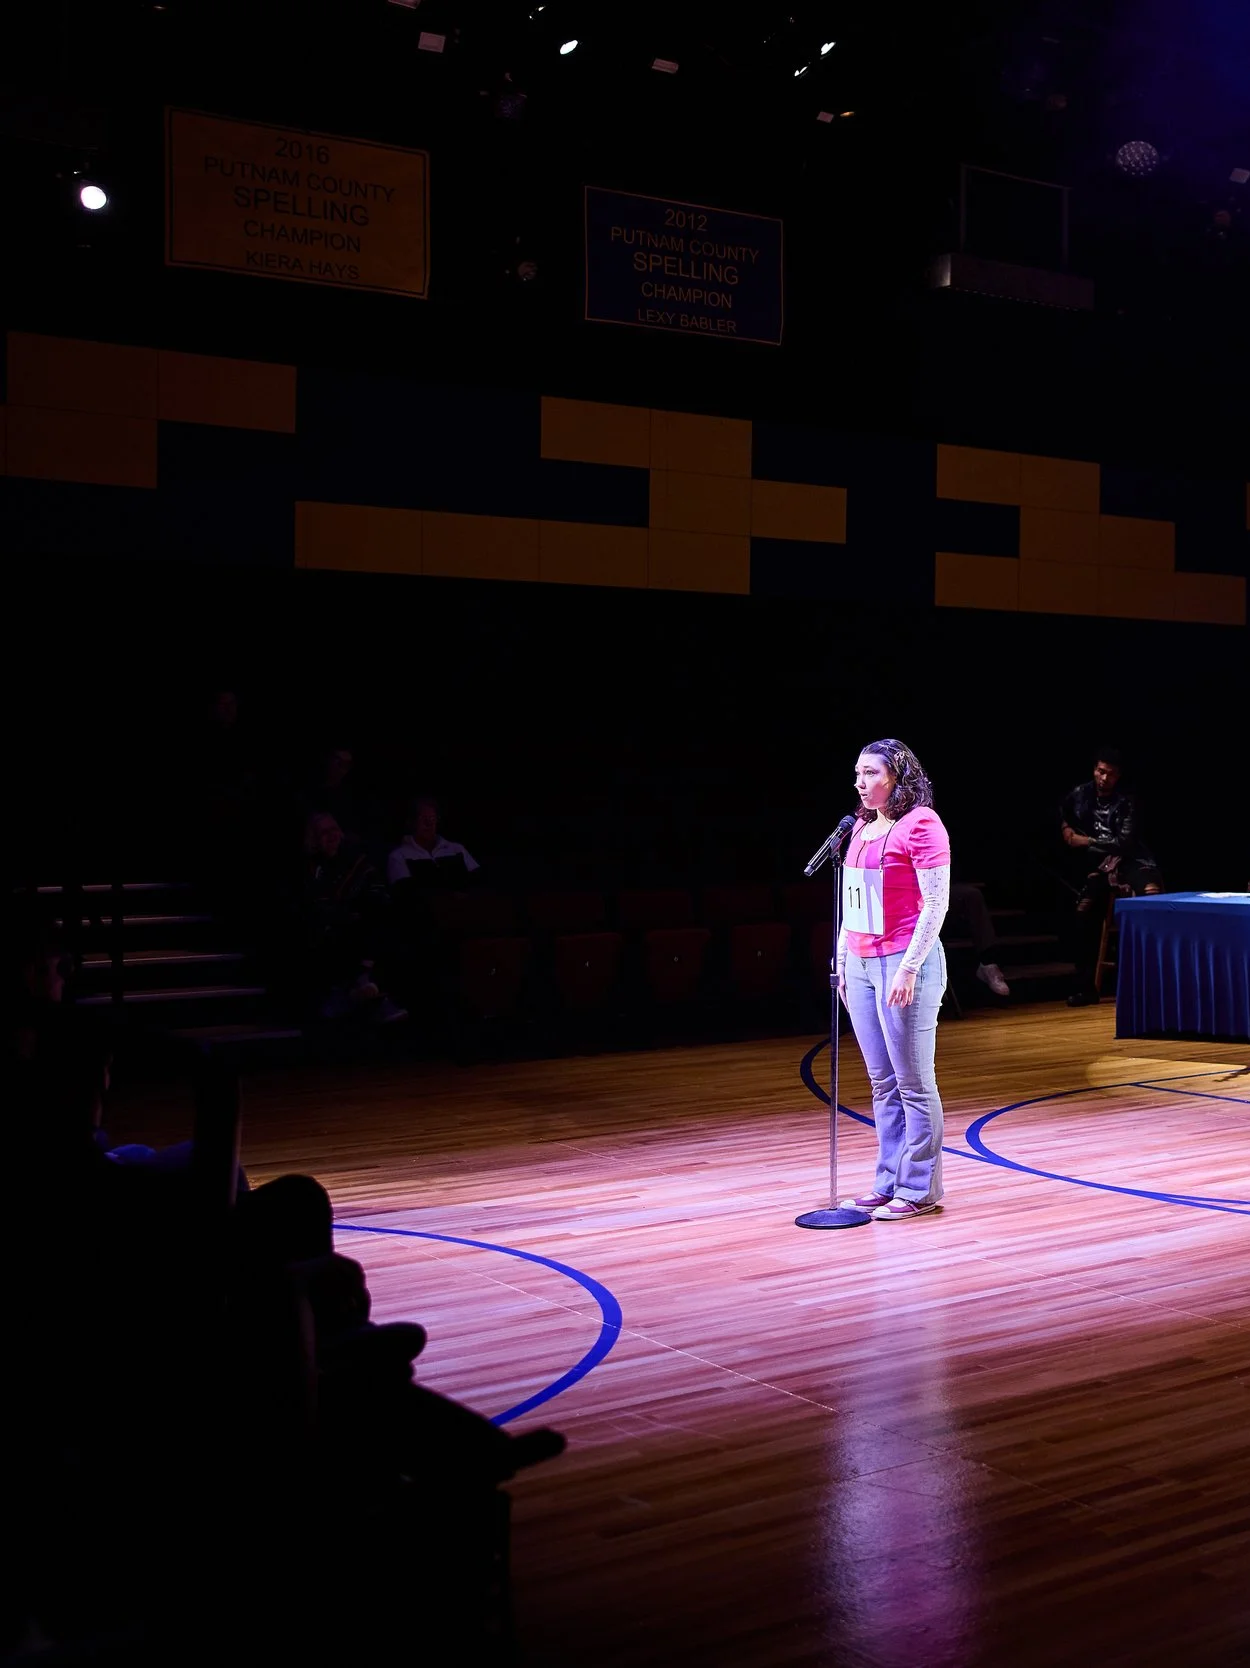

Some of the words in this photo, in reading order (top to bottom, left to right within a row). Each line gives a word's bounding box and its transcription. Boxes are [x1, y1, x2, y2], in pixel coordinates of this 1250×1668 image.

[275, 136, 330, 165] 2016
[203, 156, 300, 188] PUTNAM
[306, 172, 395, 204] COUNTY
[233, 185, 370, 226] SPELLING
[663, 208, 709, 232] 2012
[243, 220, 361, 254] CHAMPION
[611, 226, 685, 253] PUTNAM
[689, 238, 760, 265] COUNTY
[246, 250, 304, 273] KIERA
[310, 263, 361, 281] HAYS
[632, 251, 740, 286] SPELLING
[640, 281, 733, 309] CHAMPION
[637, 308, 677, 326] LEXY
[848, 886, 861, 909] 11
